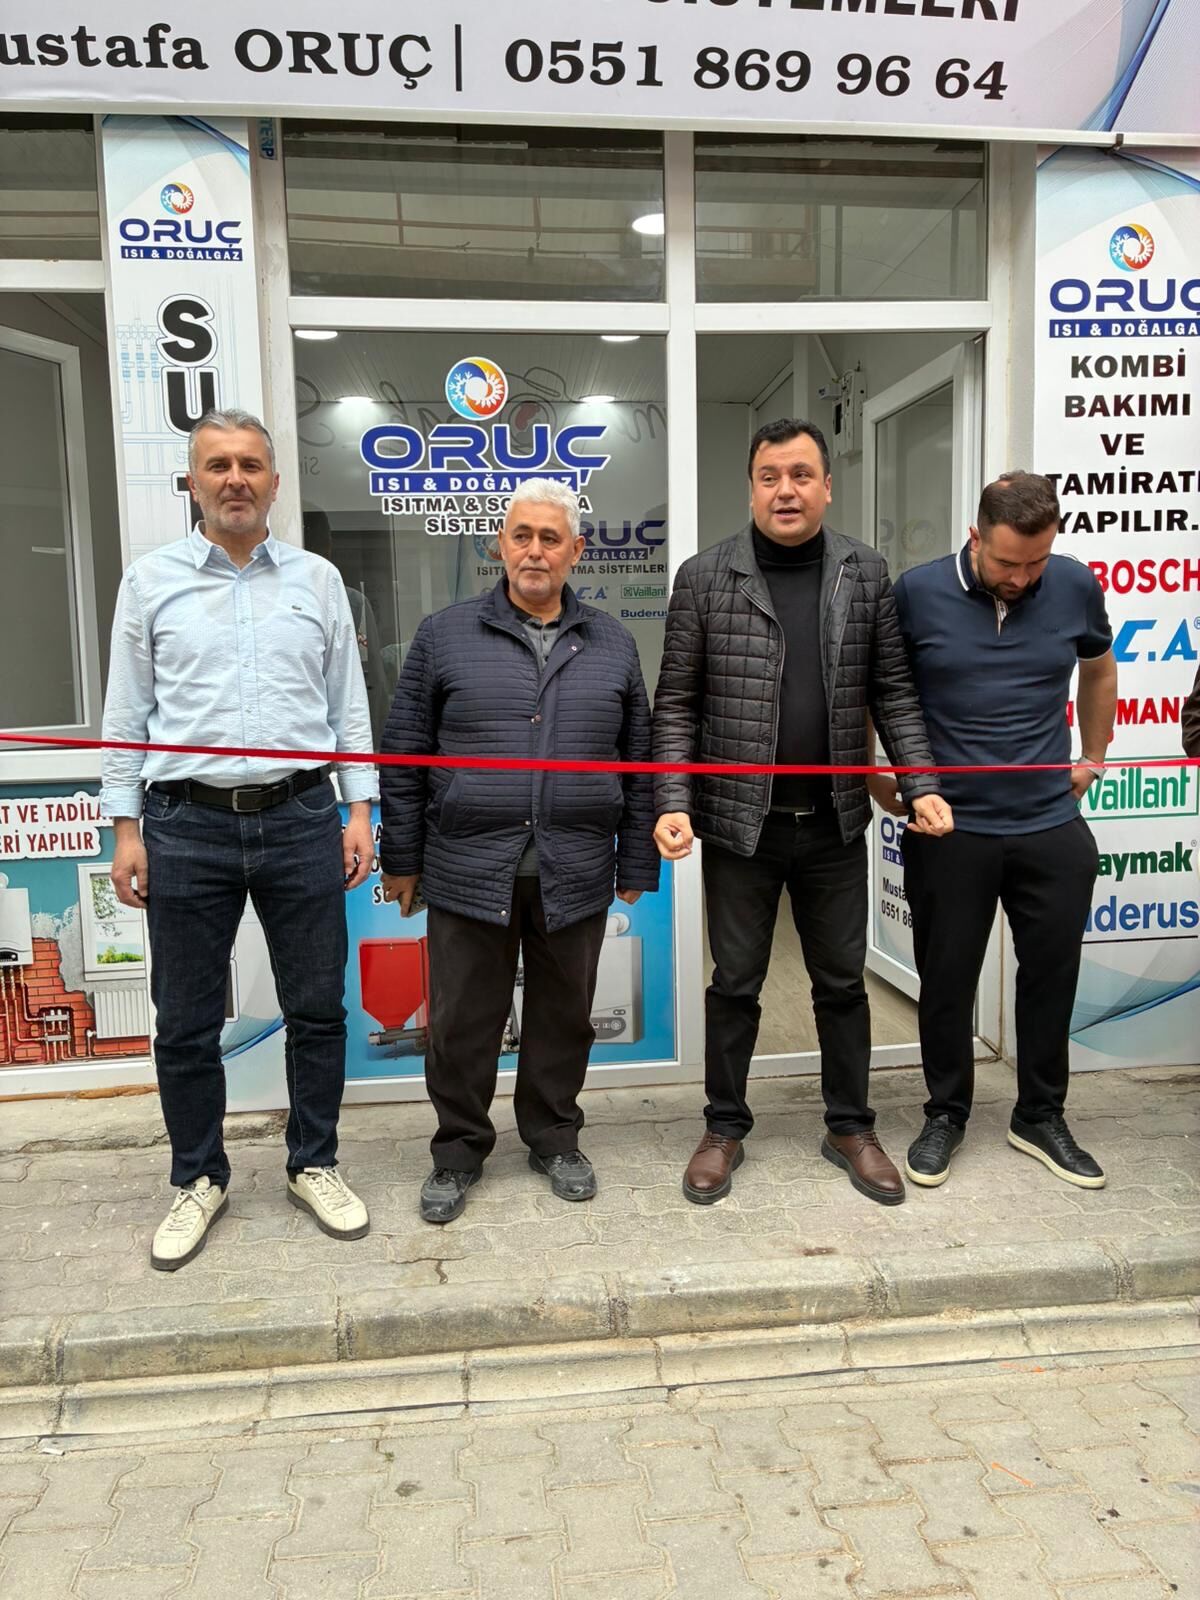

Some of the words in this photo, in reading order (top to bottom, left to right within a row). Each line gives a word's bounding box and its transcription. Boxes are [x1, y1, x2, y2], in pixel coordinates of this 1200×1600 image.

[0, 23, 209, 69] ustafa
[234, 28, 432, 89] ORUÇ
[504, 38, 663, 86] 0551
[693, 46, 811, 92] 869
[836, 53, 911, 97] 96
[935, 58, 1008, 100] 64
[119, 218, 242, 248] ORUÇ
[124, 249, 144, 258] ISI
[167, 249, 240, 260] DOĞALGAZ
[1054, 324, 1080, 337] ISI
[1090, 325, 1102, 337] &
[1112, 320, 1198, 337] DOĞALGA
[1071, 348, 1187, 379] KOMBİ
[1064, 393, 1192, 418] BAKIMI
[360, 425, 610, 485] ORUÇ
[1100, 433, 1145, 456] VE
[378, 477, 410, 491] ISI
[423, 477, 437, 491] &
[1044, 465, 1200, 496] TAMİRAT
[383, 497, 457, 513] ISITMA
[465, 497, 479, 512] &
[426, 514, 504, 533] SİSTEM
[579, 520, 666, 555] RUÇ
[582, 550, 646, 560] OĞALGAZ
[1112, 618, 1198, 663] C.A
[17, 804, 39, 823] VE
[26, 831, 94, 853] YAPILIR
[1097, 841, 1193, 882] aymak
[881, 899, 900, 922] 0551
[902, 910, 913, 929] 86
[1085, 895, 1200, 932] derus
